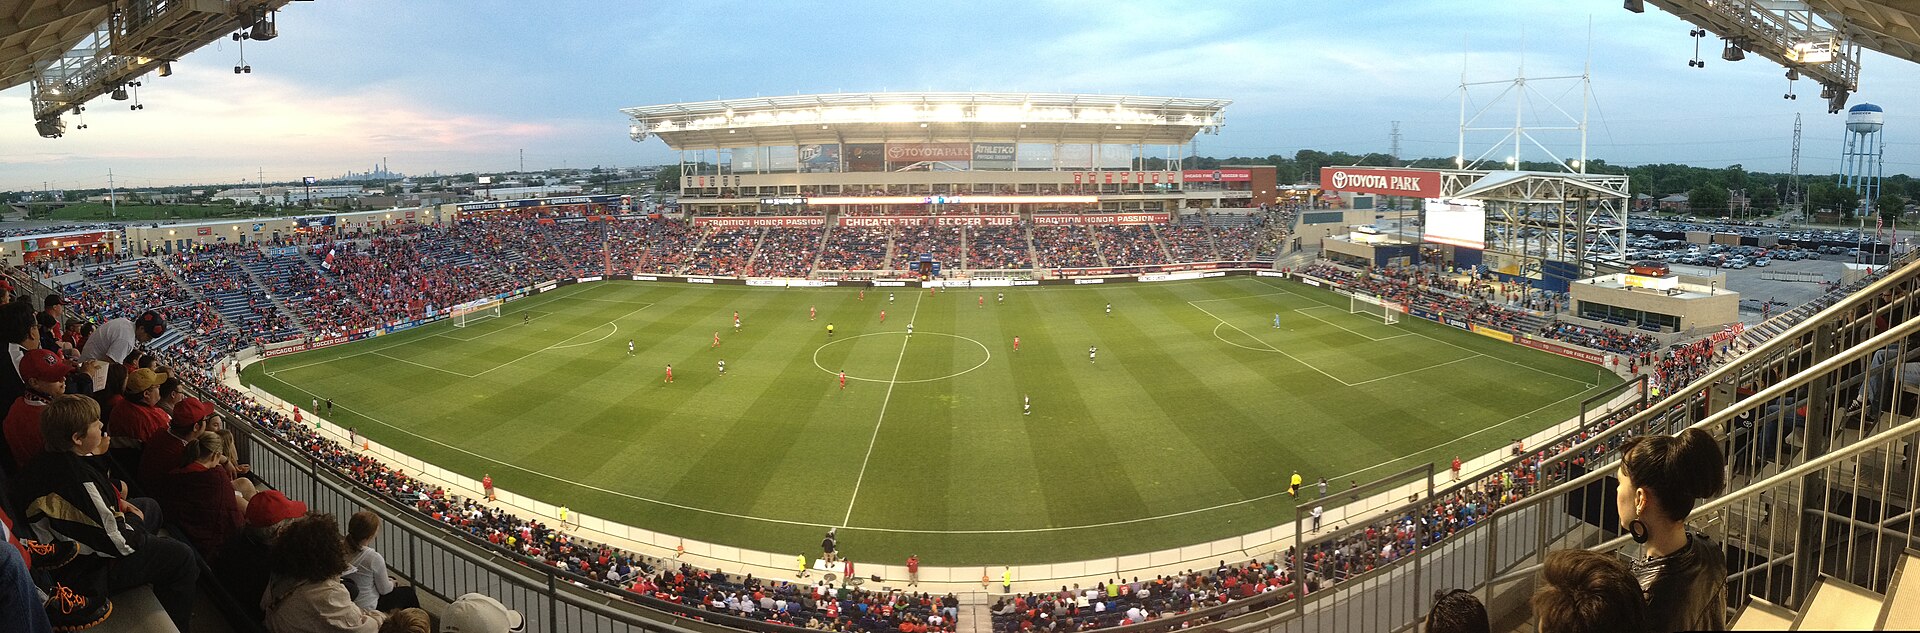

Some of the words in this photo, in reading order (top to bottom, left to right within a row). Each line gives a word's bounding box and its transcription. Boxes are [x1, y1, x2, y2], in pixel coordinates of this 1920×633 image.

[905, 147, 944, 157] TOYOTA
[944, 147, 969, 156] PARK
[1347, 174, 1388, 189] TOYOTA
[1390, 175, 1421, 191] PARK
[753, 218, 783, 226] HONOR
[785, 218, 824, 226] PASSION
[845, 218, 895, 226] CHICAGO
[938, 217, 981, 226] SOCCER
[985, 217, 1013, 226] CLUB
[266, 347, 293, 357] CHICAGO
[293, 344, 306, 352] FIRE
[312, 339, 334, 348] SOCCER
